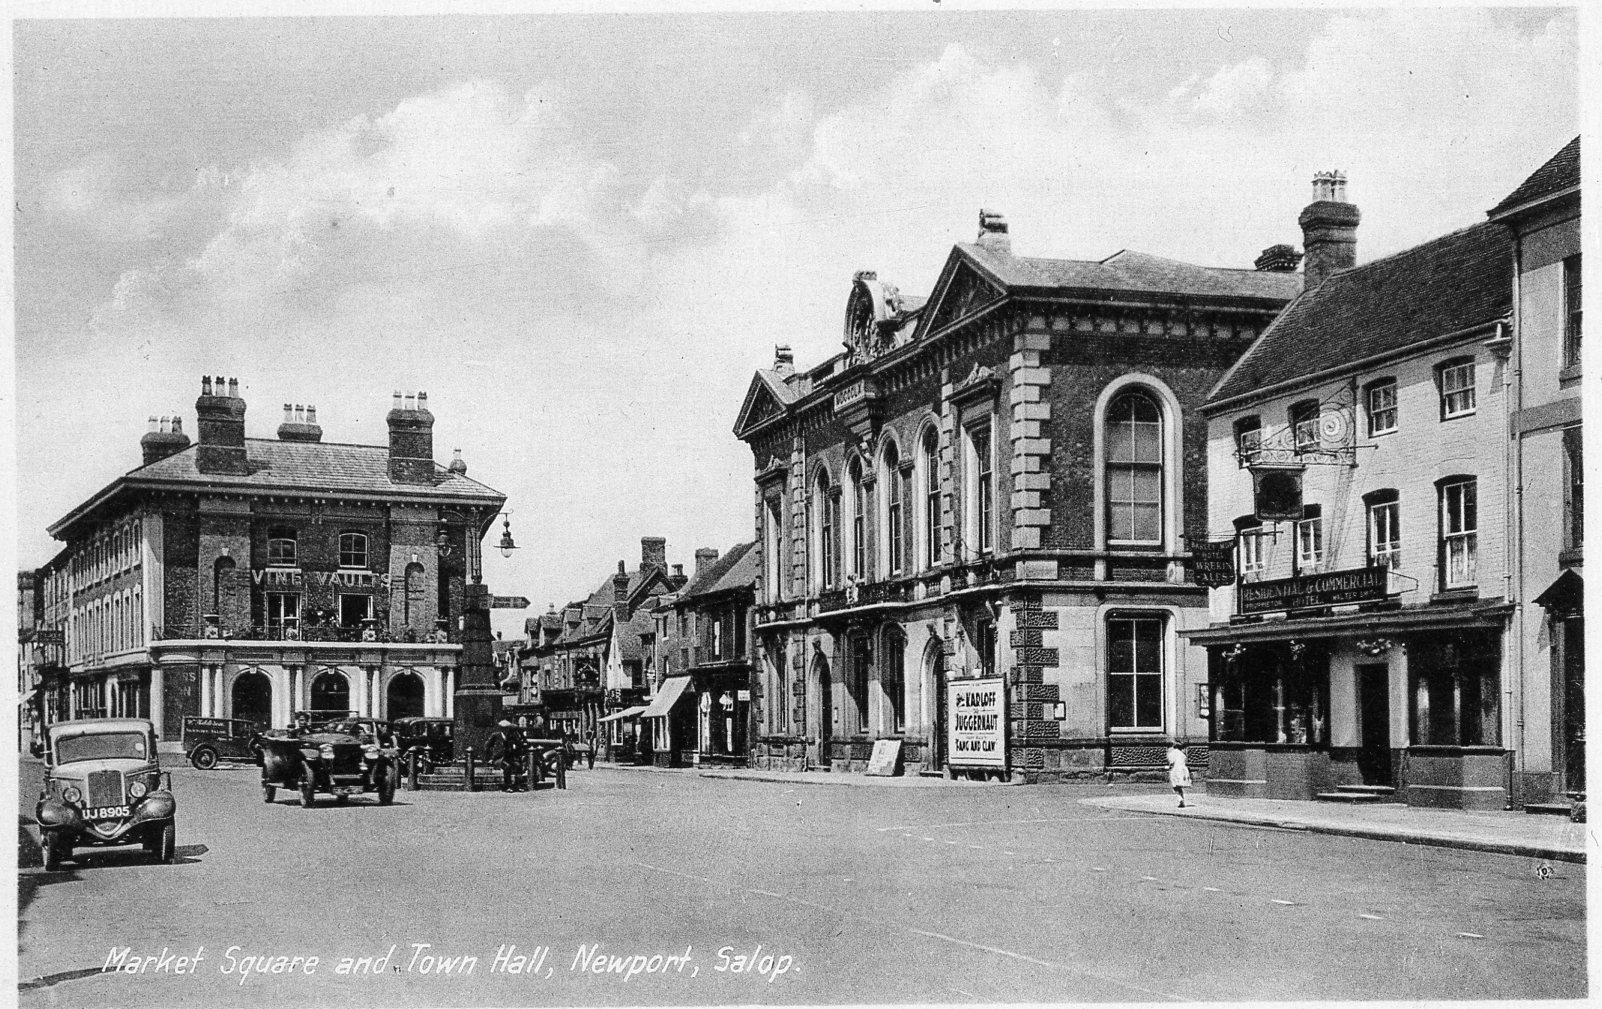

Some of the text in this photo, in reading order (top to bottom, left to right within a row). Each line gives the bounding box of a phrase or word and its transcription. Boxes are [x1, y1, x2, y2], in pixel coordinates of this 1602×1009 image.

[1196, 561, 1232, 571] WREKIN
[251, 569, 390, 588] VINE VAULTS
[1243, 581, 1305, 601] RESIDENTIAL
[1316, 572, 1384, 593] COMMERCIAL
[966, 691, 996, 707] KARLOFF
[955, 713, 998, 731] JUGGERNAUT
[971, 740, 981, 752] AND
[82, 806, 130, 820] UJ 8905
